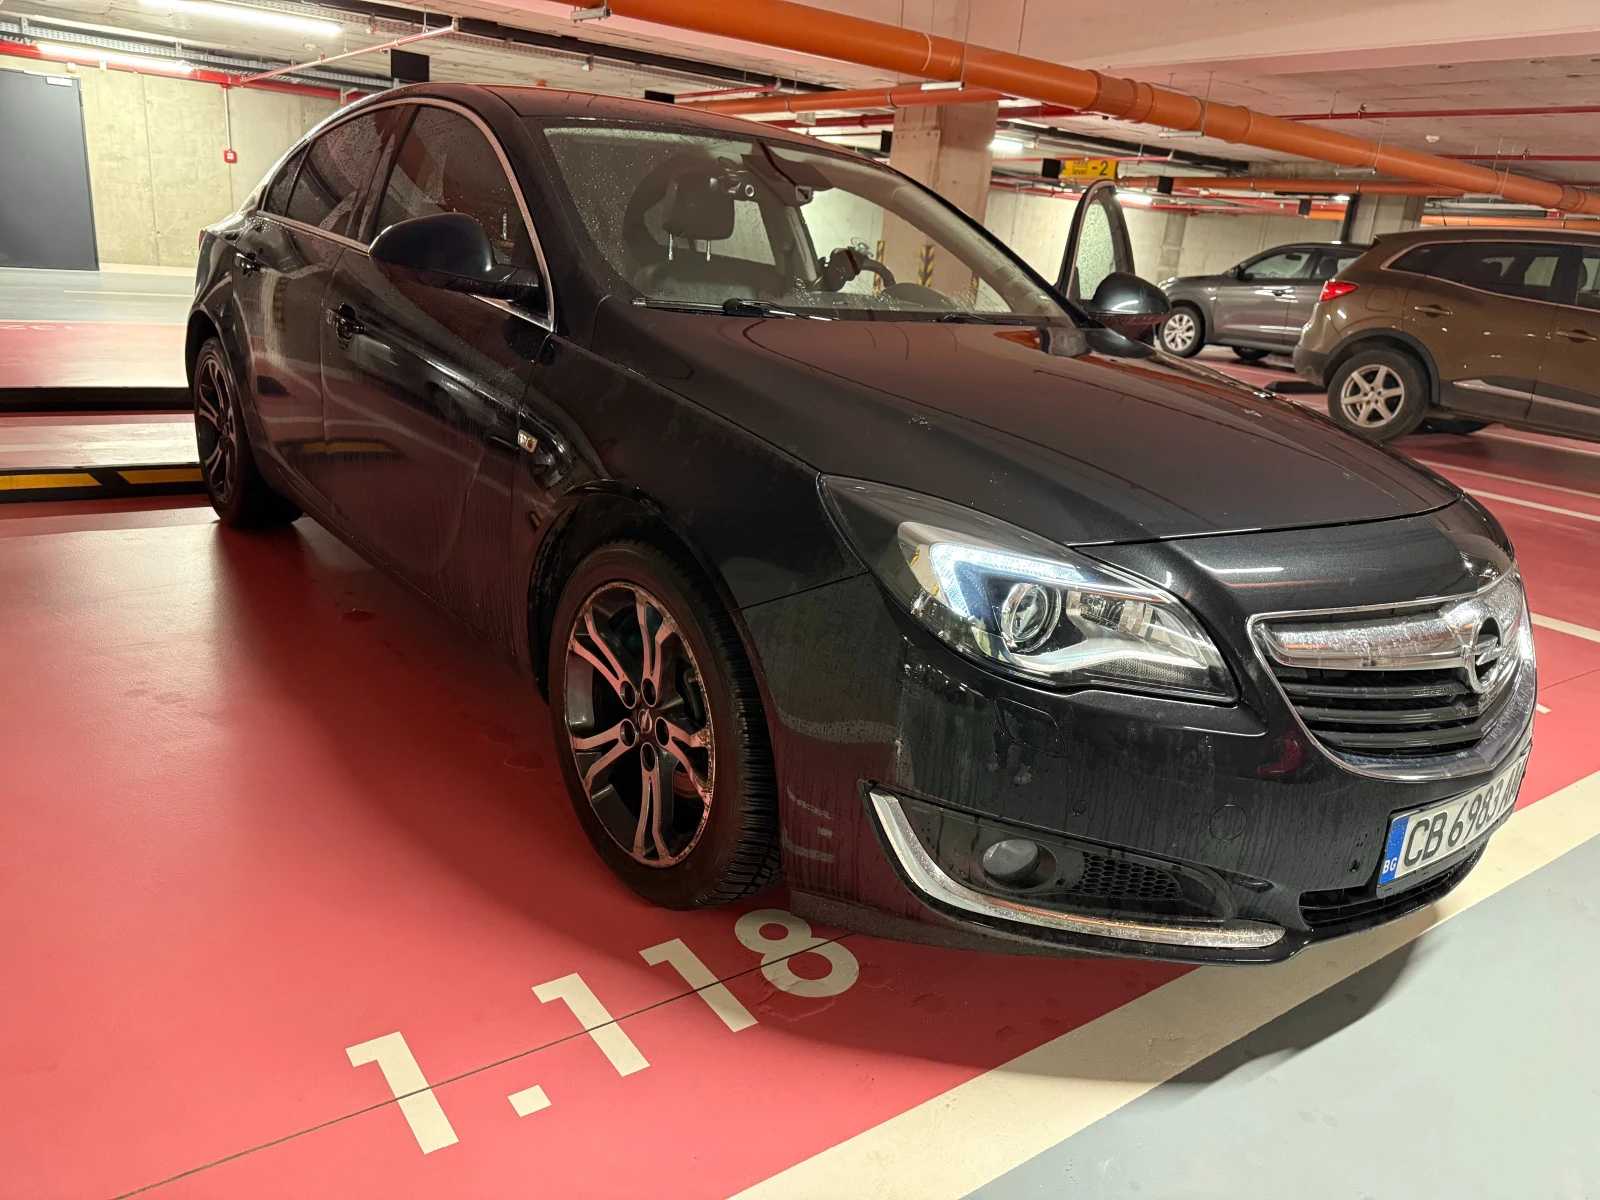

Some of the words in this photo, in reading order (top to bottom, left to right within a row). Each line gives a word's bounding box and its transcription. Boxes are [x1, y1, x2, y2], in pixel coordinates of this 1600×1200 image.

[1091, 160, 1109, 176] -2
[1403, 811, 1448, 868] CB
[1447, 778, 1504, 848] 6983
[1382, 857, 1398, 875] BG
[345, 908, 860, 1155] 1.118
